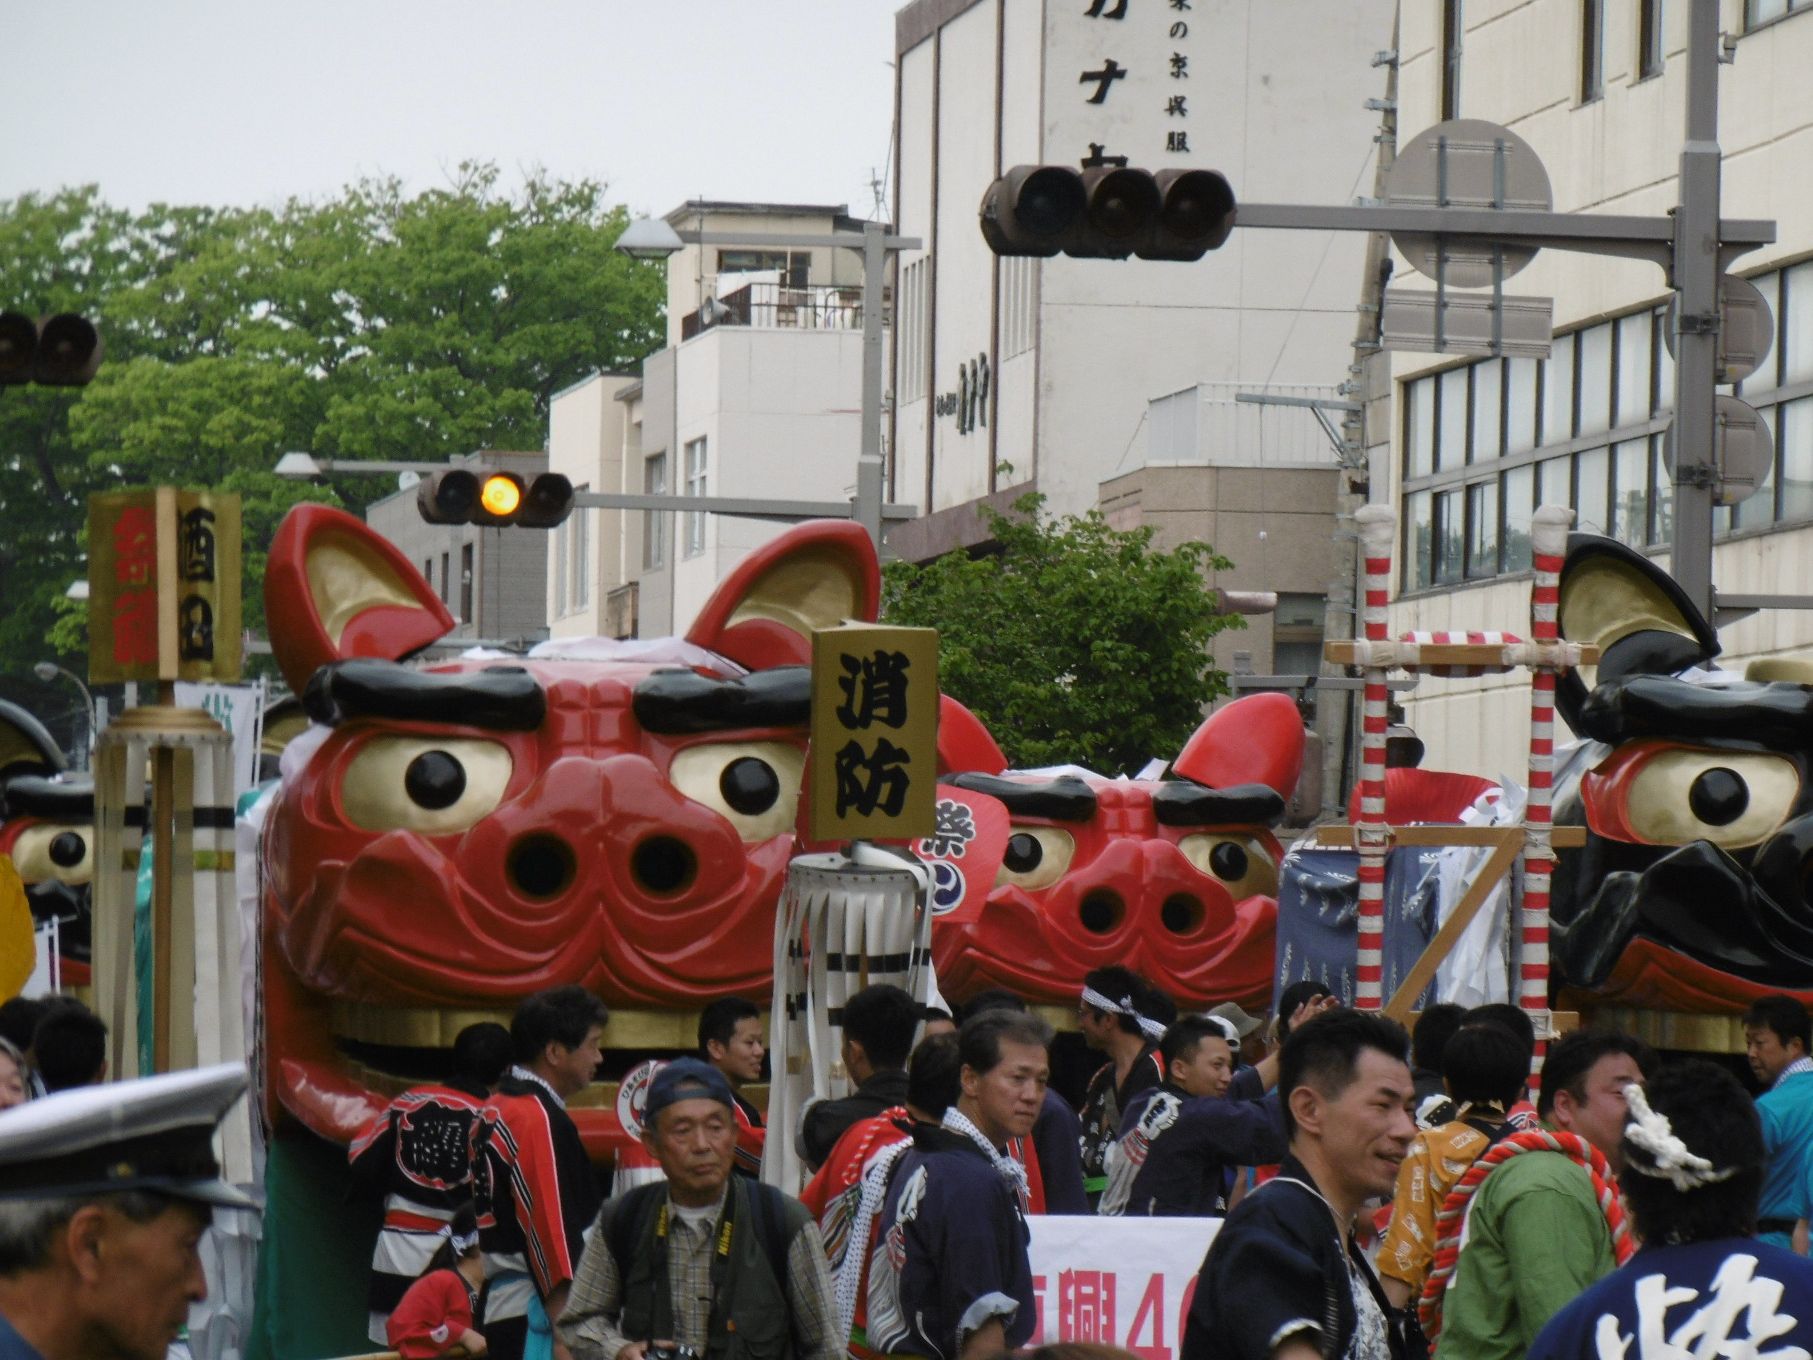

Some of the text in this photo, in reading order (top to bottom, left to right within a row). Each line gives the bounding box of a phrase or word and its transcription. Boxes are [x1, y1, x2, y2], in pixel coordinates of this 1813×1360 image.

[835, 650, 911, 820] 消防
[919, 799, 976, 860] 祭
[1032, 1268, 1200, 1360] 興4
